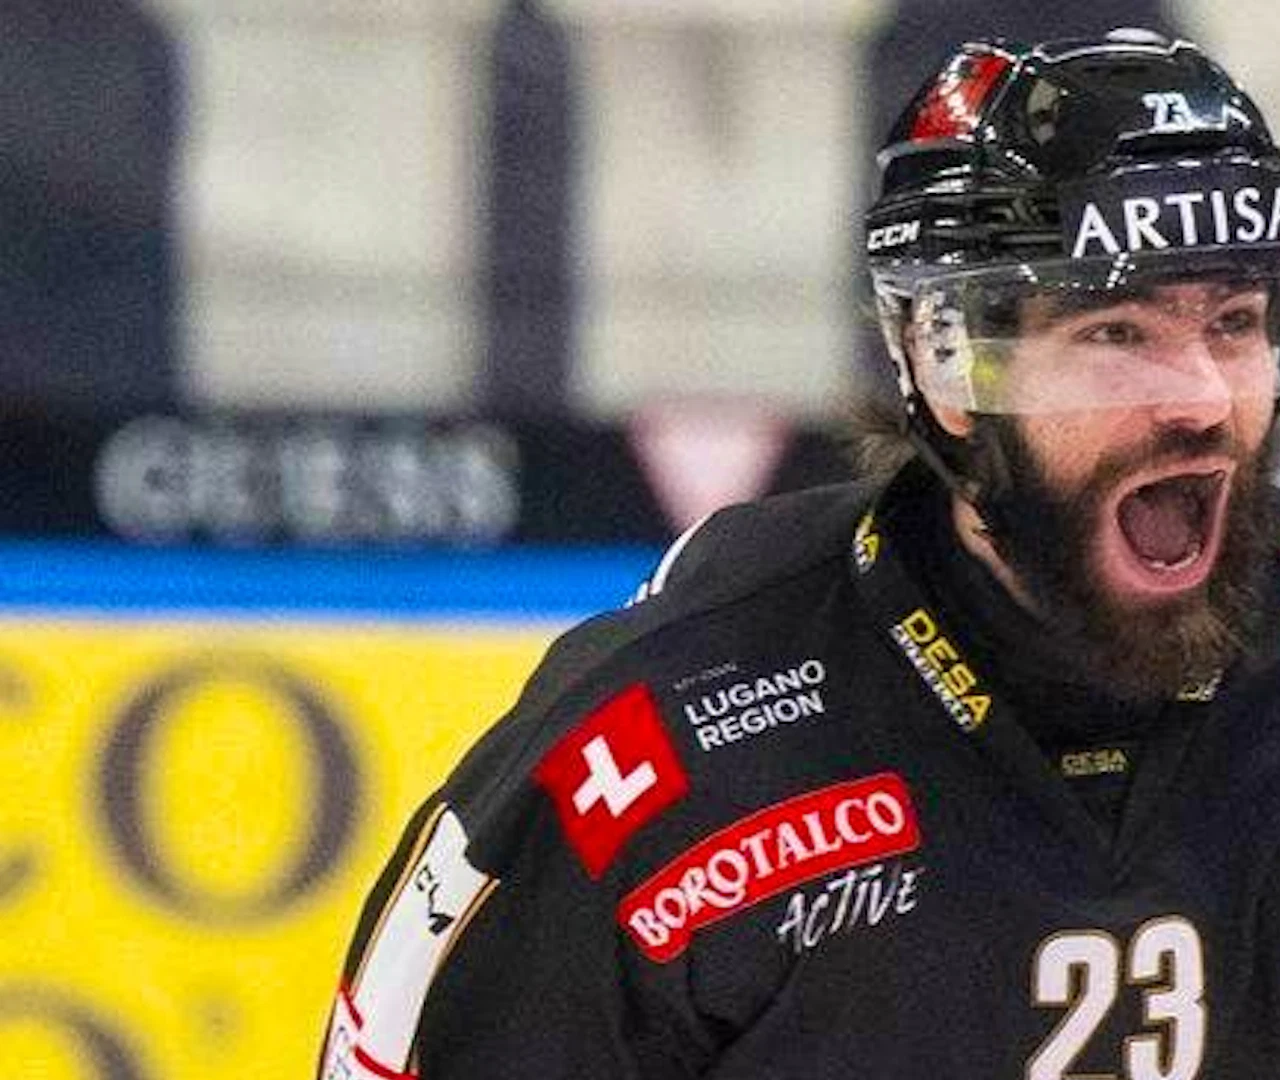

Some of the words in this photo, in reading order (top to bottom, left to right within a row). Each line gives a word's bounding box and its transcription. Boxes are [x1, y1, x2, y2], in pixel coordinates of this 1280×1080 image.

[867, 221, 921, 251] CCM
[684, 659, 825, 726] LUGANO
[902, 608, 992, 724] DESA
[696, 690, 825, 752] REGION
[628, 791, 904, 948] BOROTALCO
